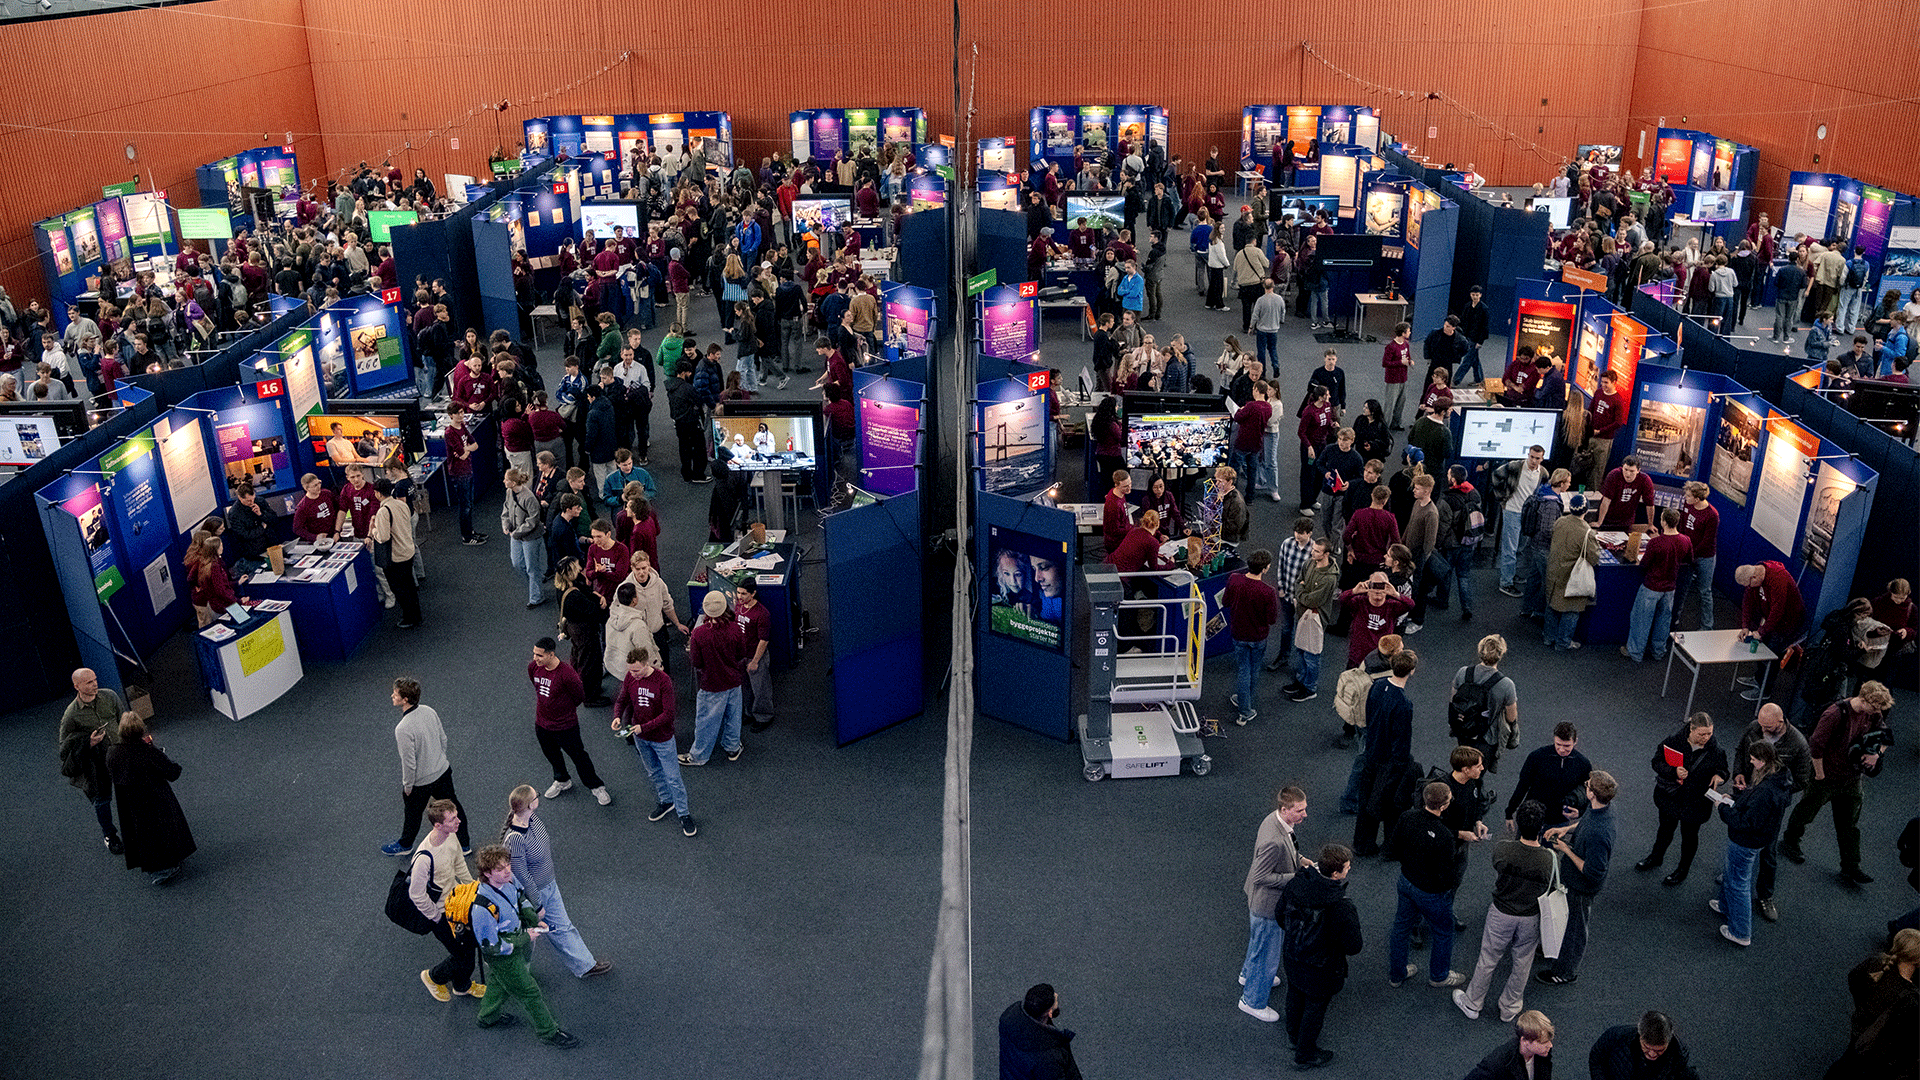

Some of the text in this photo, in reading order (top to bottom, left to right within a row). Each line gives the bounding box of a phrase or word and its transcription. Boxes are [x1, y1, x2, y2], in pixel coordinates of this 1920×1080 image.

[1022, 285, 1035, 295] 29
[386, 291, 398, 301] 17
[1032, 375, 1046, 388] 28
[262, 383, 279, 395] 16
[1636, 448, 1665, 458] Fremtiden
[1368, 613, 1380, 622] DTU
[1010, 619, 1058, 638] byggeprojekter
[540, 677, 552, 687] DTU
[638, 687, 650, 697] DTU
[1125, 761, 1165, 770] SAFELIFT
